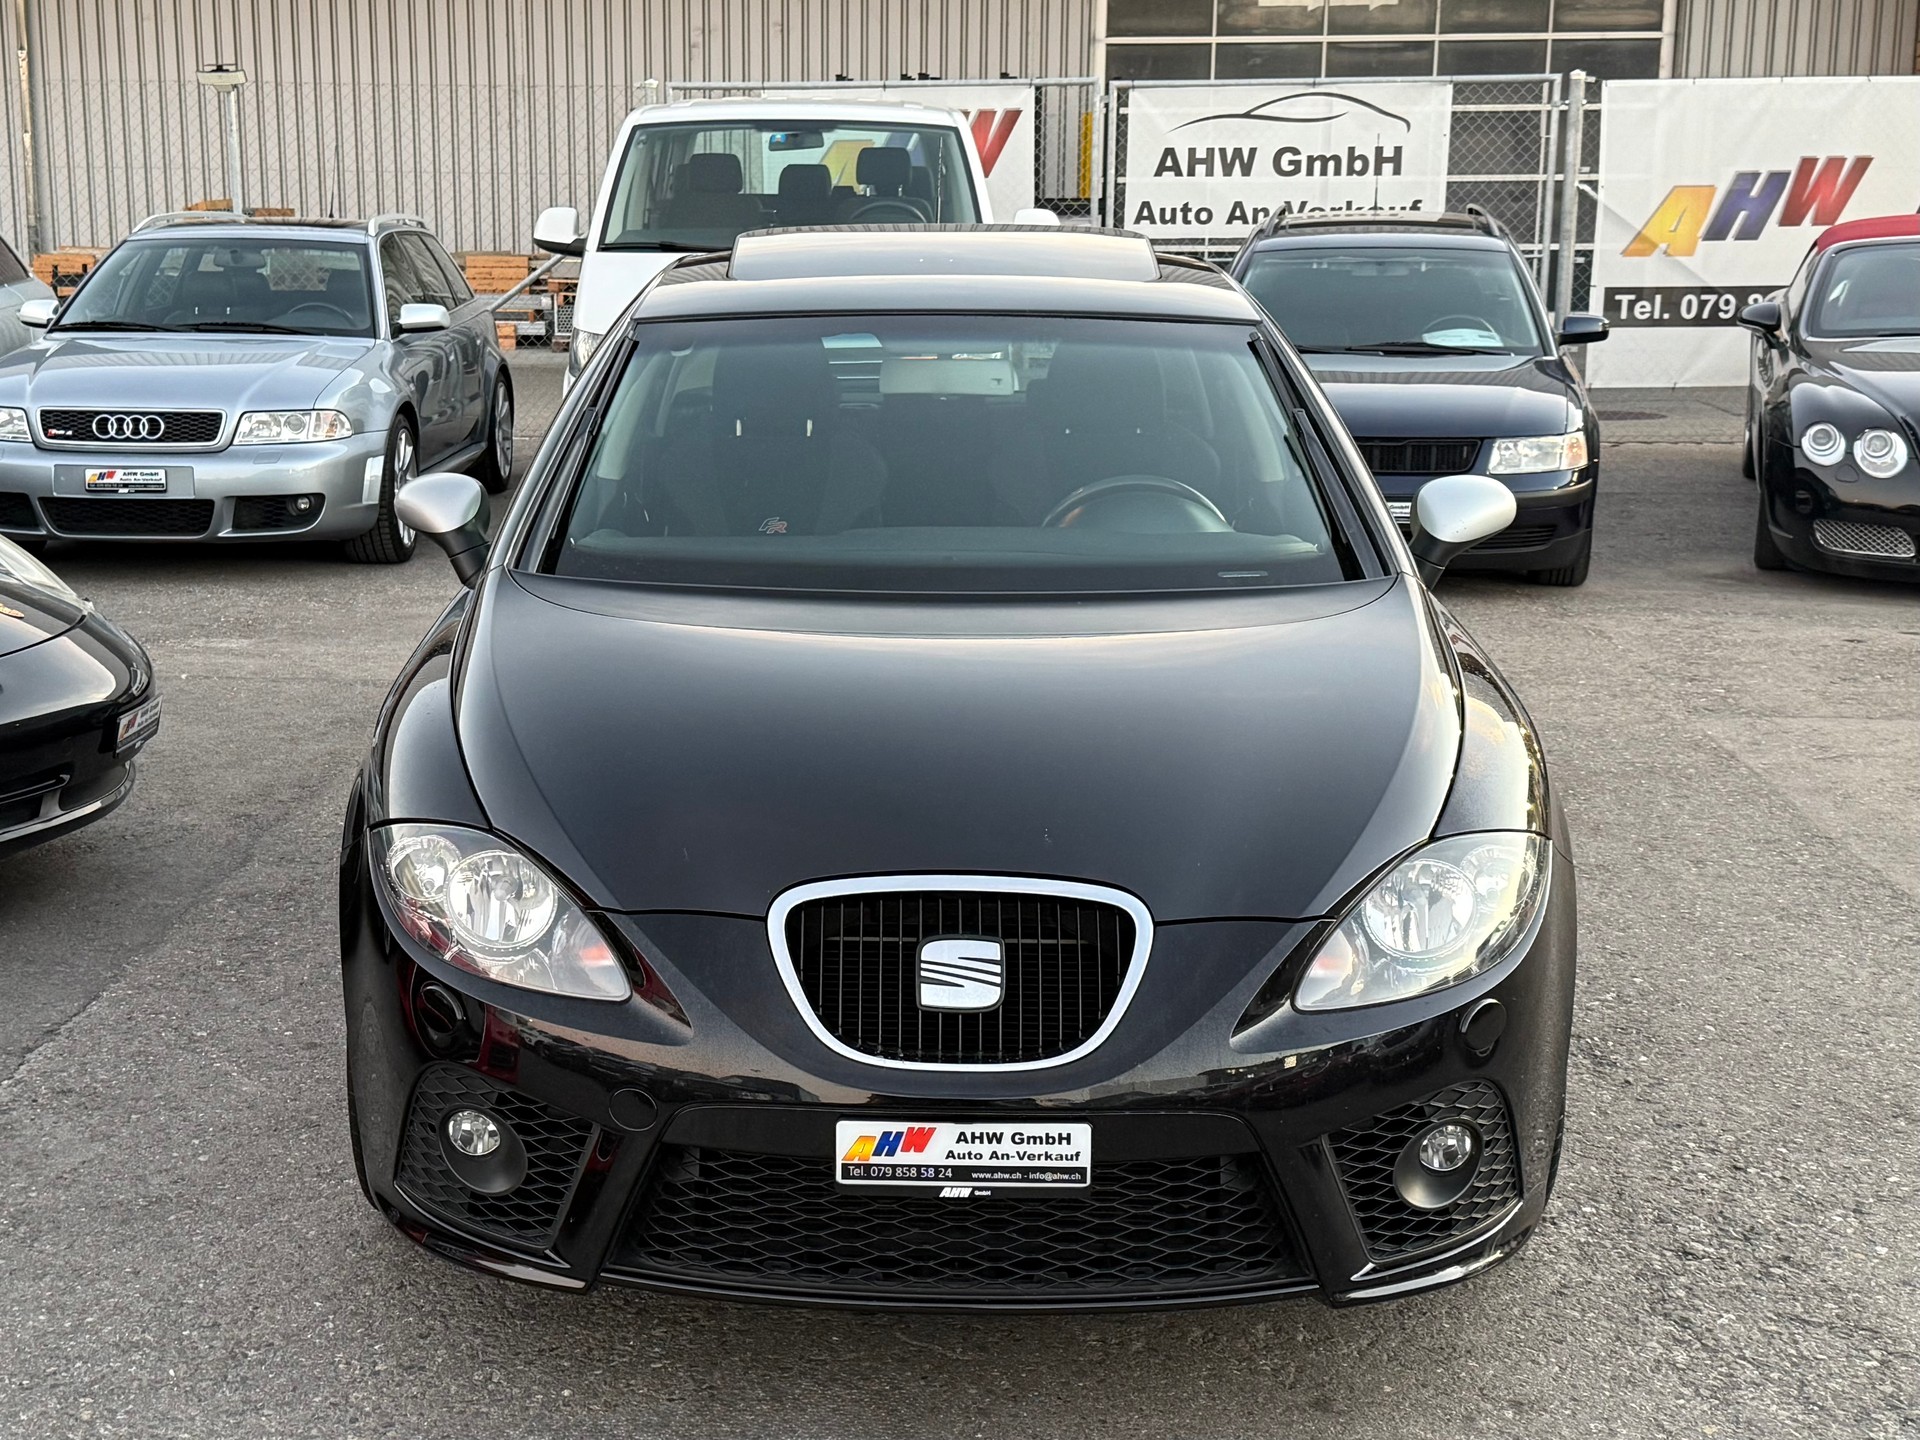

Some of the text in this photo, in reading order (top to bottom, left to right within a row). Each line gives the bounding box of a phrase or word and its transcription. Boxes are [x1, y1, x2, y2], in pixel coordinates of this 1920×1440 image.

[1153, 146, 1403, 177] AHW GmbH
[1133, 200, 1214, 225] Auto
[1619, 155, 1875, 257] AHW
[1614, 294, 1670, 320] Tel.
[1680, 293, 1737, 320] 079
[841, 1127, 937, 1162] AHW
[955, 1131, 1072, 1146] AHW GmbH
[945, 1150, 1081, 1163] Auto An-Verkauf
[847, 1165, 953, 1178] Tel. 079 858 58 24
[1028, 1172, 1081, 1182] info@ahw.ch
[939, 1187, 973, 1198] AHW
